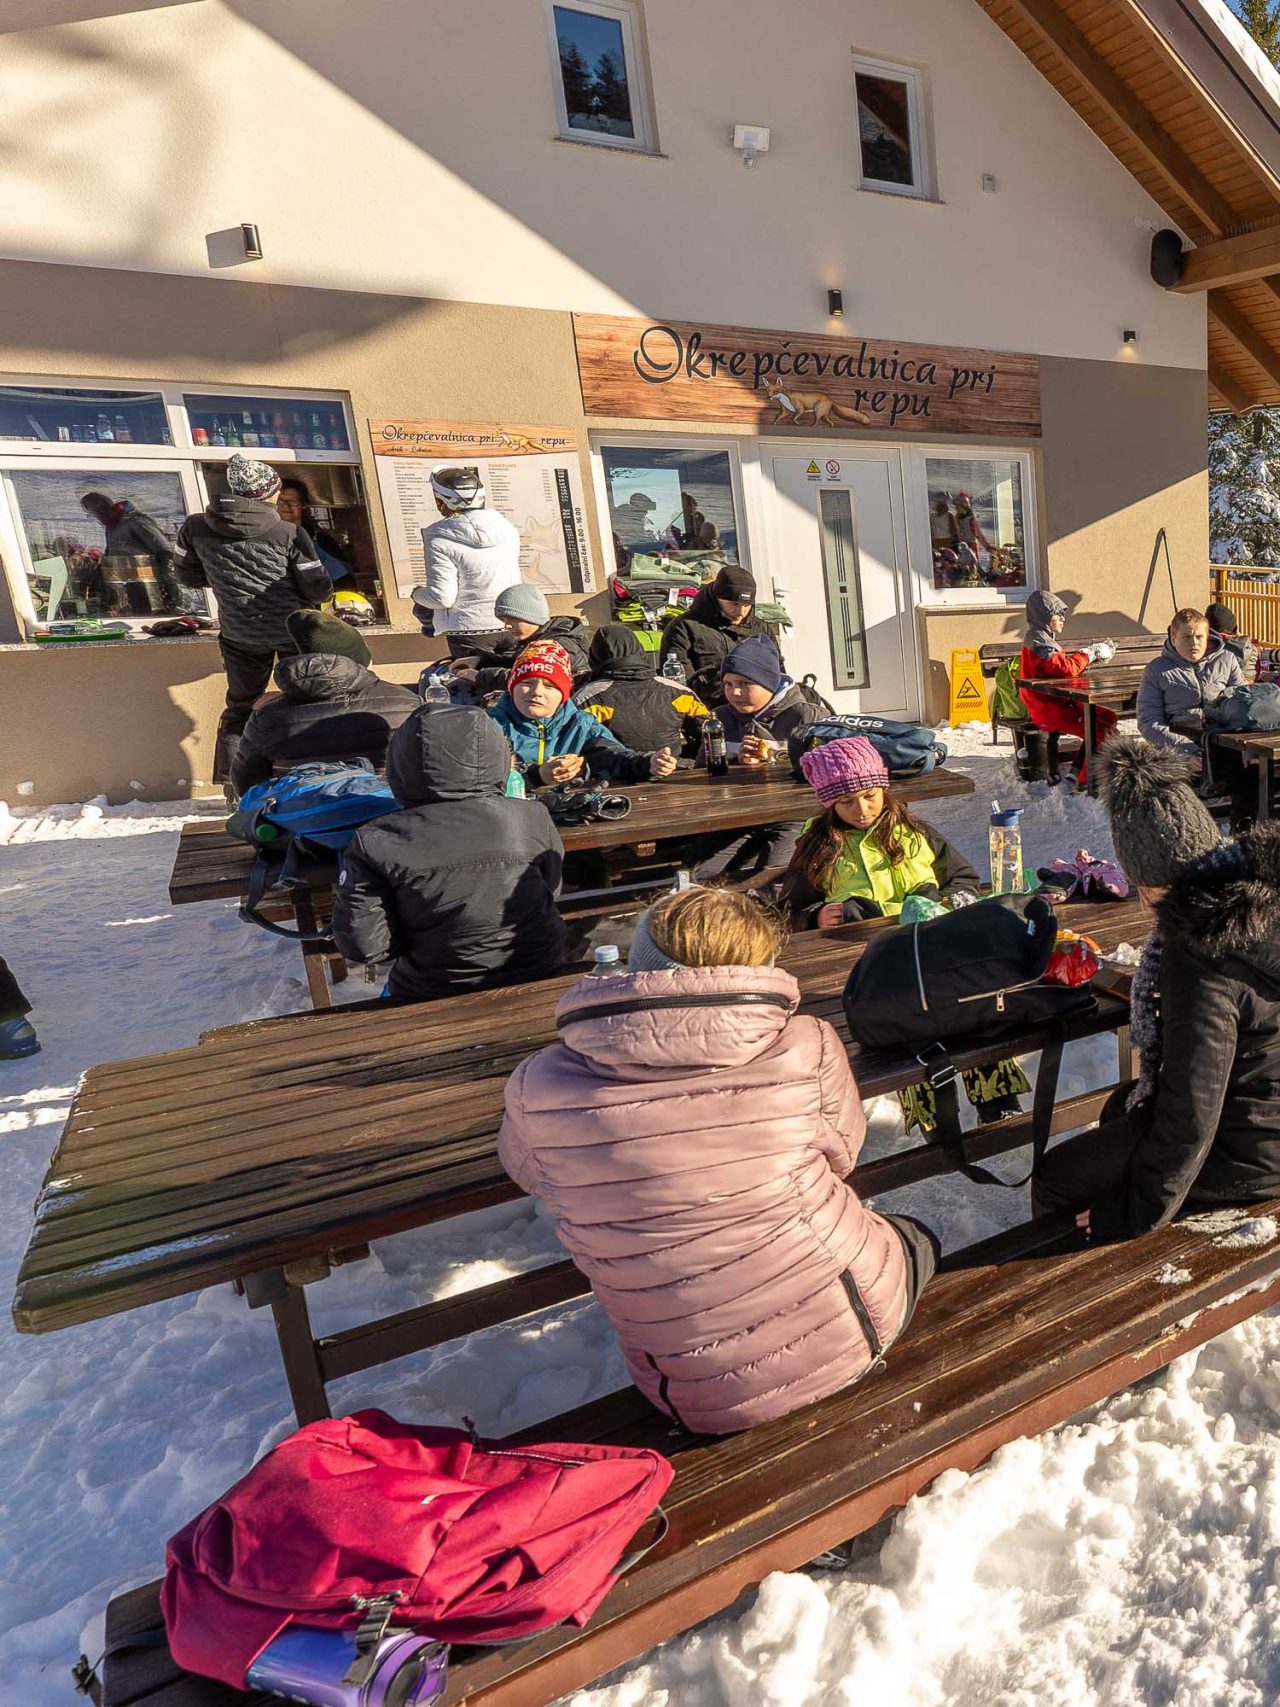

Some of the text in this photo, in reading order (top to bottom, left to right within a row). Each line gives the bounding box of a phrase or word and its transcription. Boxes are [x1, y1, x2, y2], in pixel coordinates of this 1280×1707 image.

[633, 325, 997, 400] Okrepčevalnica pri
[853, 387, 933, 426] repu
[478, 433, 495, 446] pri
[540, 436, 566, 449] repu
[574, 506, 582, 523] 16.00
[577, 528, 585, 542] 9.00
[517, 663, 554, 676] XMAS
